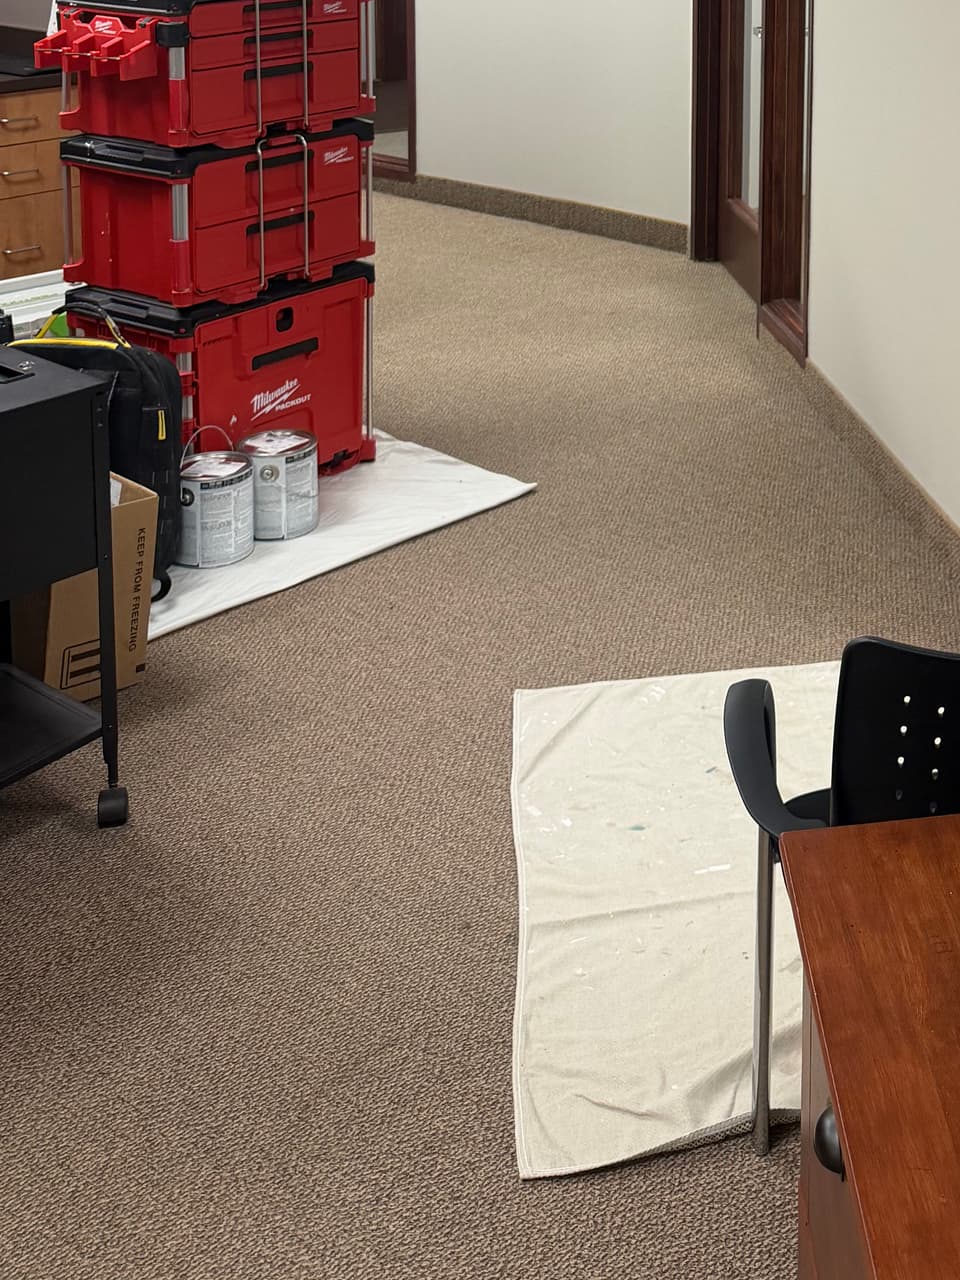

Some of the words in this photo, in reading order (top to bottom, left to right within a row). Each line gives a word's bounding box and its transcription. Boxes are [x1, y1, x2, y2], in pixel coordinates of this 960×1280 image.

[250, 378, 298, 413] Milwaukee
[136, 527, 146, 557] KEEP
[133, 560, 144, 593] FROM
[128, 596, 141, 652] FREEZING
